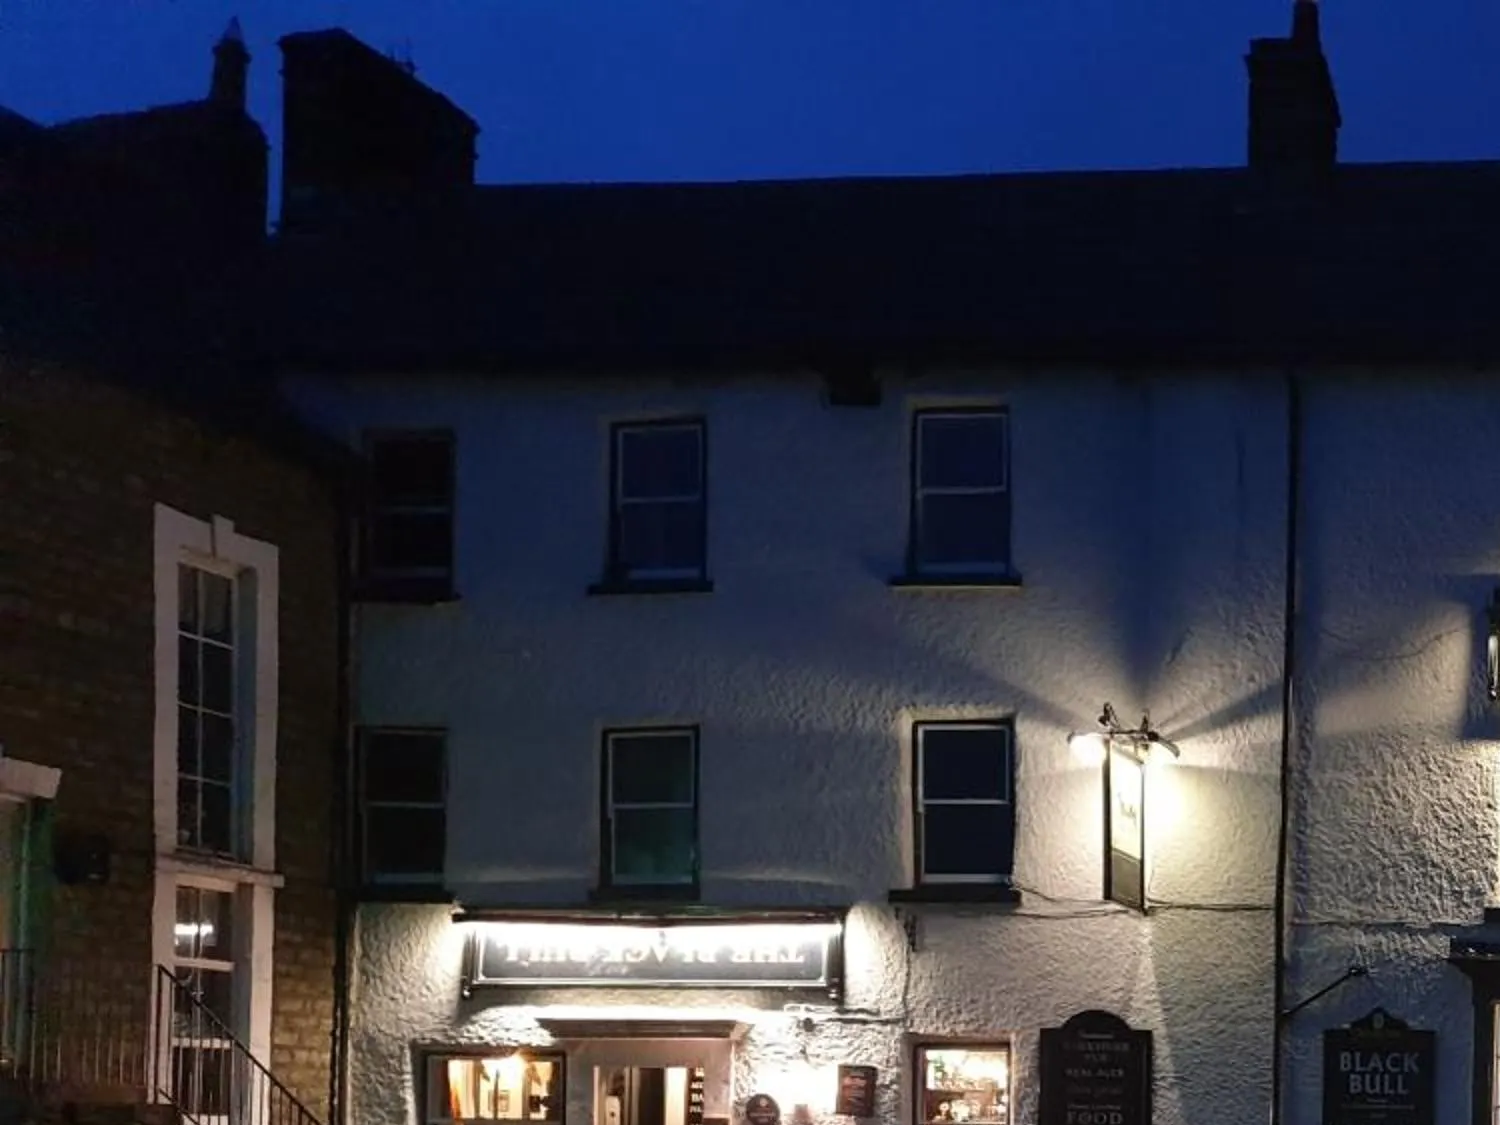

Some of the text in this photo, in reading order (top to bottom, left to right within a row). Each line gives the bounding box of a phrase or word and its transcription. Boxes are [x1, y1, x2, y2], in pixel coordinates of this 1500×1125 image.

[1340, 1051, 1419, 1073] BLACK
[1349, 1073, 1410, 1095] BULL
[1066, 1111, 1123, 1125] FOOD
